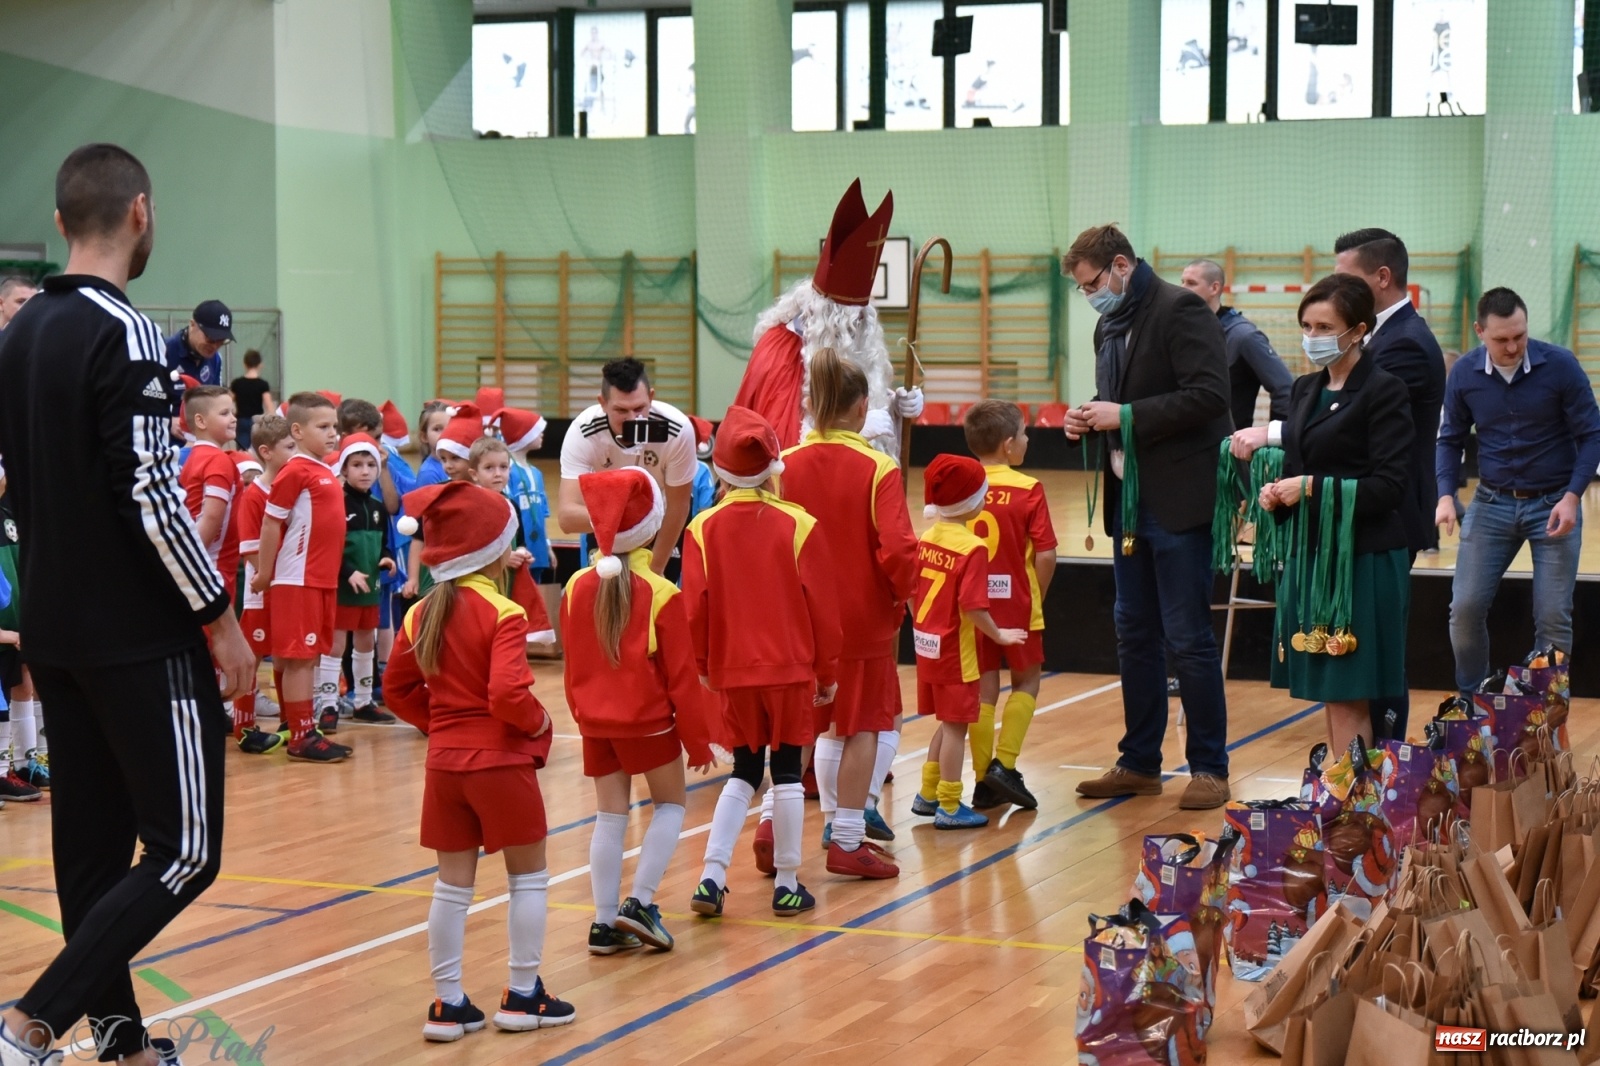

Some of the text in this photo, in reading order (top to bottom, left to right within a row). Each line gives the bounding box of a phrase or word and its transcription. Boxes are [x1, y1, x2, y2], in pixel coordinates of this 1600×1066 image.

[142, 388, 168, 400] adidas
[996, 491, 1011, 505] 21
[965, 510, 1000, 563] 9
[944, 554, 955, 570] 21
[987, 580, 1009, 588] EXIN
[916, 567, 946, 624] 7
